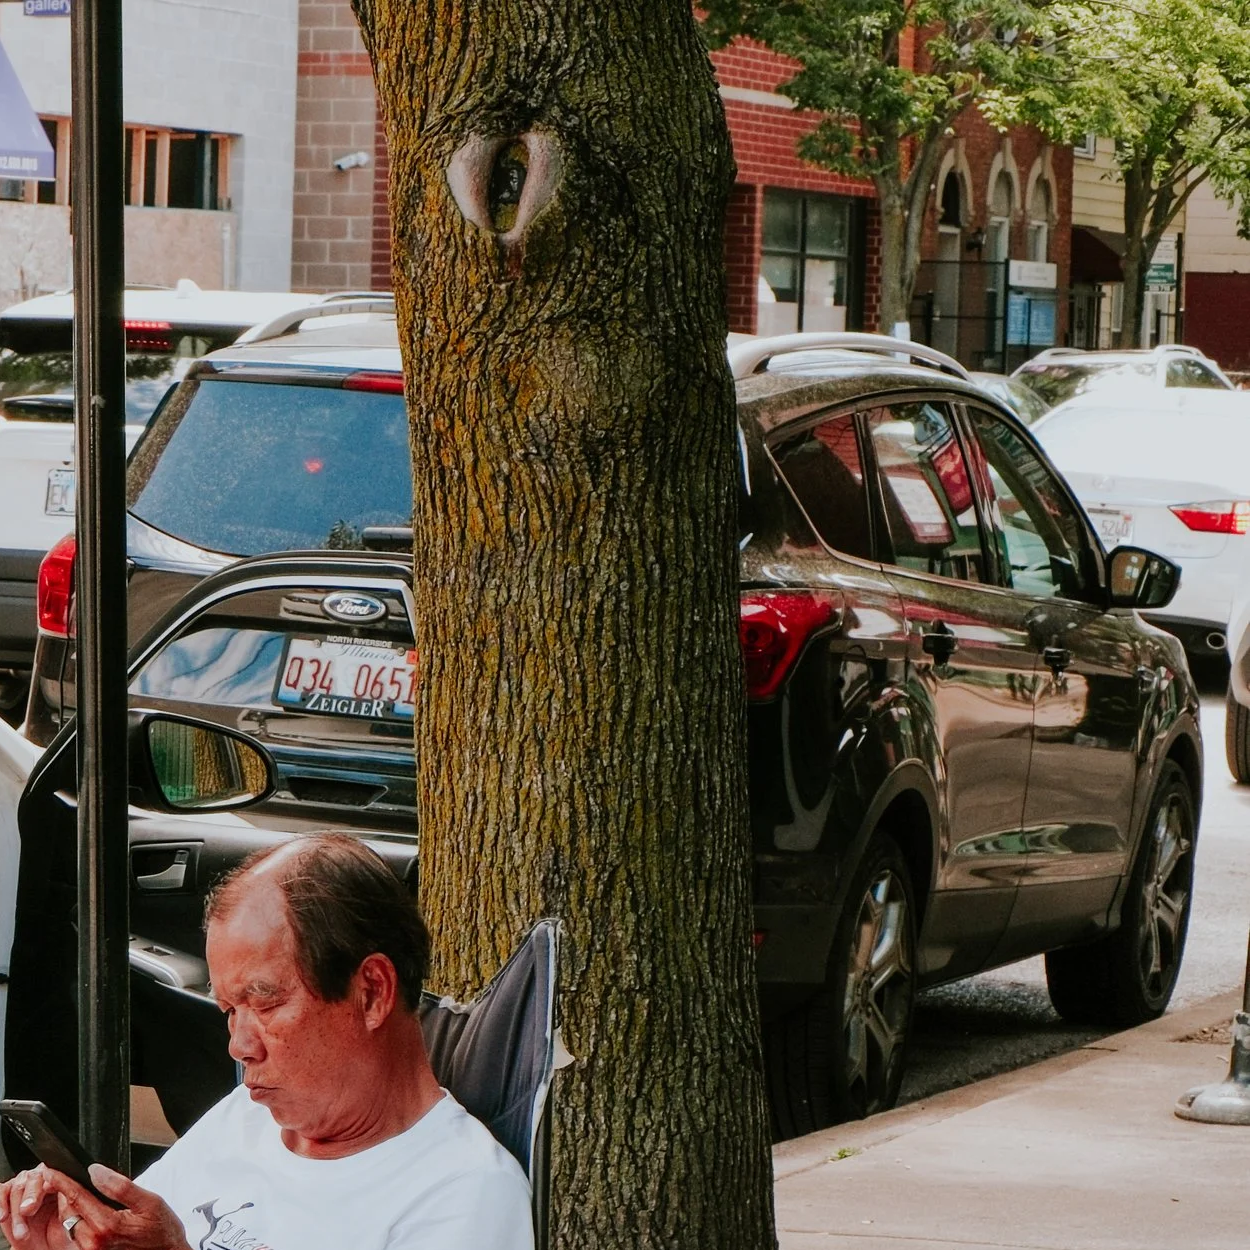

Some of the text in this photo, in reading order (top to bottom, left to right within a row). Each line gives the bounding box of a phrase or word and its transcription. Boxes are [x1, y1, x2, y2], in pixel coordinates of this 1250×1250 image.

[336, 597, 371, 616] Ford
[326, 635, 393, 649] NORTH RIVERSIDE
[338, 643, 395, 662] Illinois
[354, 663, 416, 706] 0651
[305, 692, 386, 718] ZEIGLER
